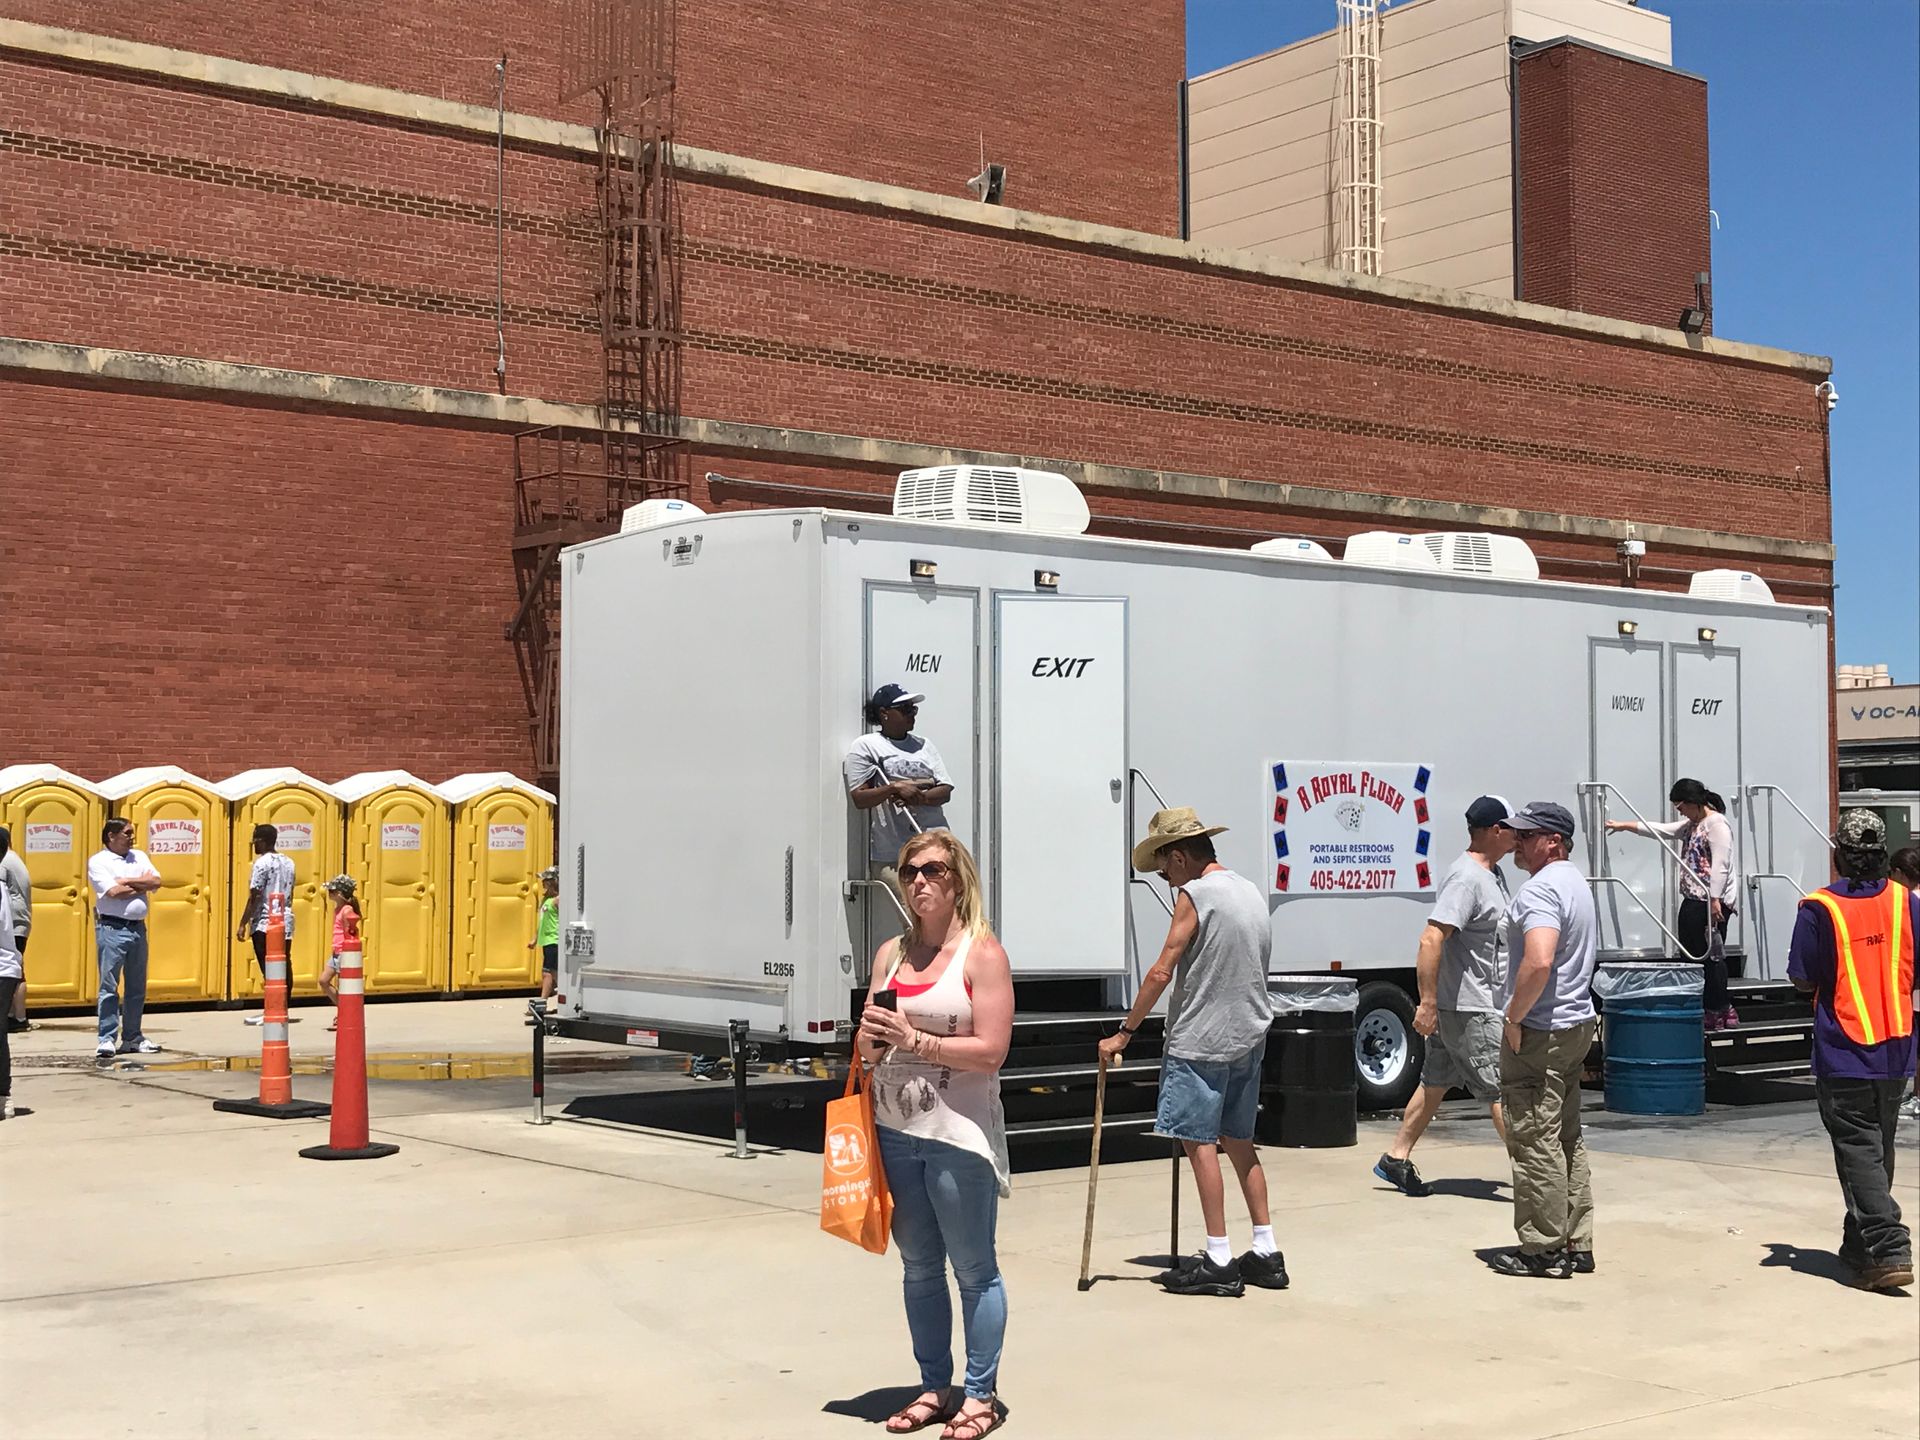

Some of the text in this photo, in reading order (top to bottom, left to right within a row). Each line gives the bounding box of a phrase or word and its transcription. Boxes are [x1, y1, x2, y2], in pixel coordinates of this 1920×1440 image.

[905, 653, 942, 673] MEN
[1031, 657, 1095, 678] EXIT
[1611, 695, 1645, 712] WOMEN
[1692, 698, 1723, 716] EXIT
[1870, 705, 1920, 719] OC-A
[1297, 770, 1406, 814] A ROYAL FLUSH
[150, 842, 200, 852] 422-2077
[1310, 844, 1394, 853] PORTABLE RESTROOMS
[1313, 855, 1391, 864] AND SEPTIC SERVICES
[1310, 870, 1396, 890] 405-422-2077
[763, 961, 795, 978] EL2856
